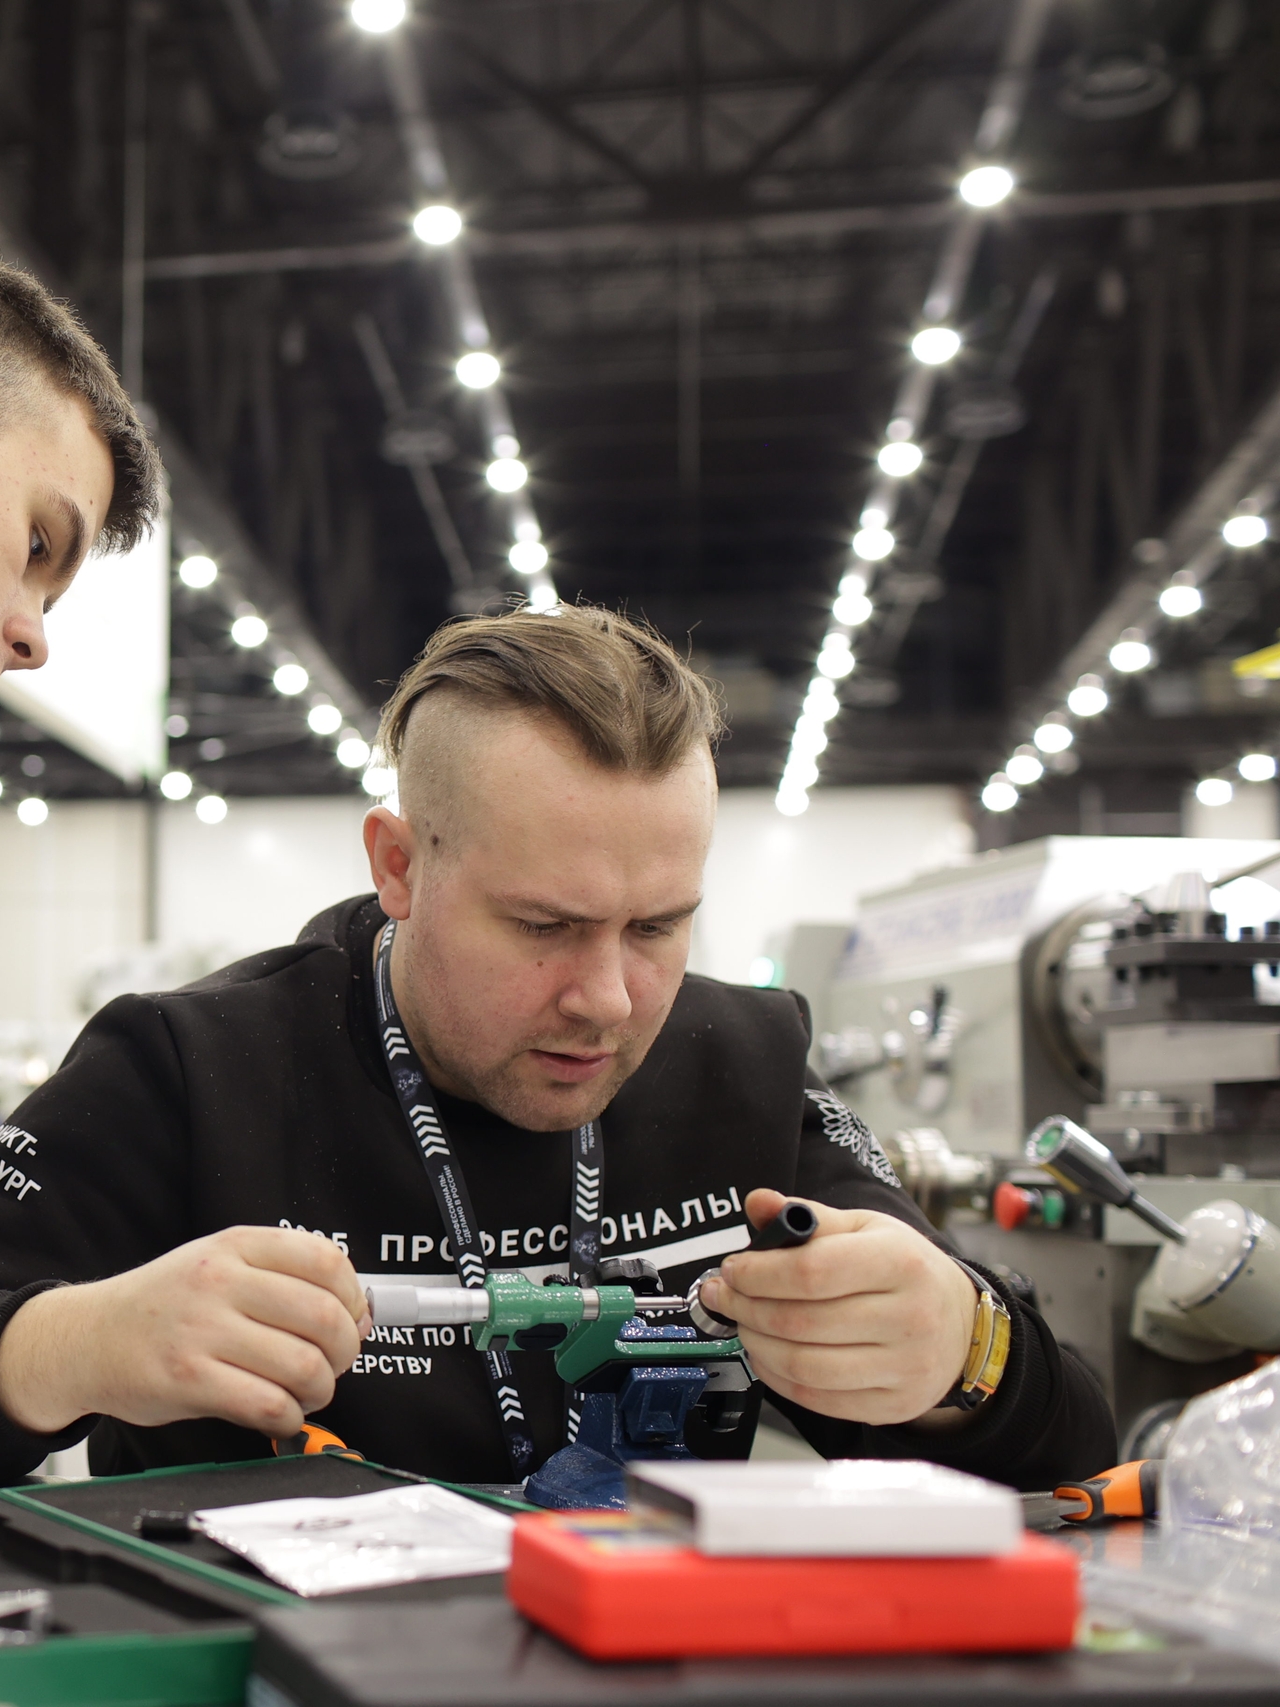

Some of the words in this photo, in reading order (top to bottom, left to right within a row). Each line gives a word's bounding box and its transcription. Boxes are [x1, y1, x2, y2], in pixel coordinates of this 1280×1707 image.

[380, 1186, 744, 1263] ПРОФЕССОНАЛЫ
[456, 1206, 472, 1245] СДЕЛАНО
[422, 1326, 456, 1347] ПО
[351, 1353, 432, 1376] ЕРСТВУ
